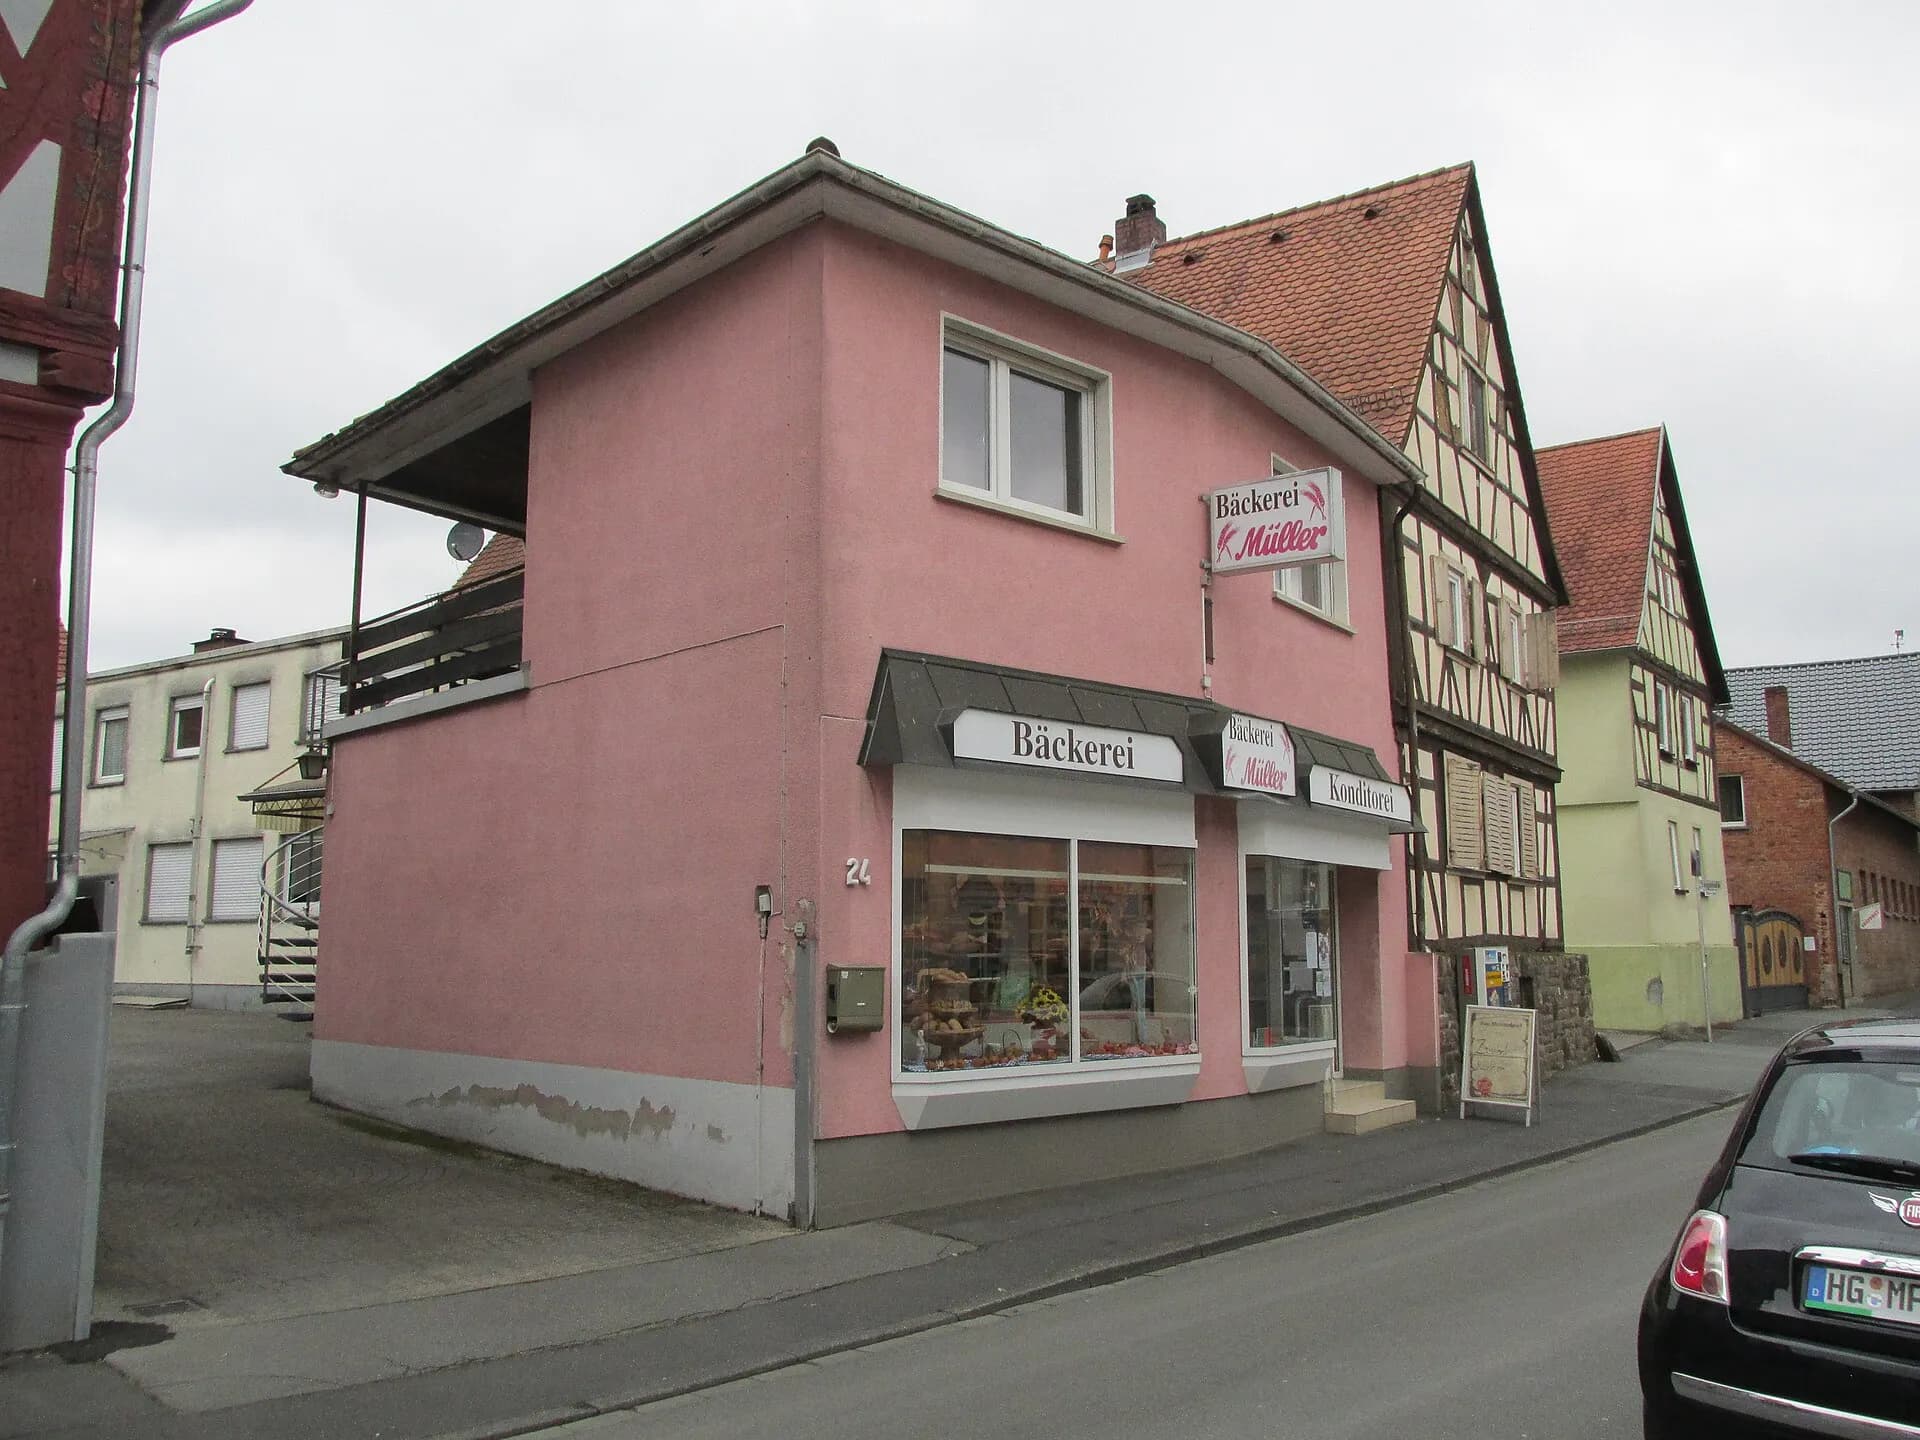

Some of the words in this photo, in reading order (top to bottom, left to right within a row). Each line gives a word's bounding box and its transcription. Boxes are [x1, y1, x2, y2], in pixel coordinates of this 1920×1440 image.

[1216, 481, 1299, 520] Bäckerei
[1235, 520, 1327, 560] Müller
[1011, 719, 1135, 770] Bäckerei
[1228, 714, 1274, 748] Bäckerei
[1241, 756, 1288, 792] Müller
[1328, 772, 1395, 813] Konditorei
[846, 857, 871, 886] 24
[1827, 1272, 1865, 1305] HG
